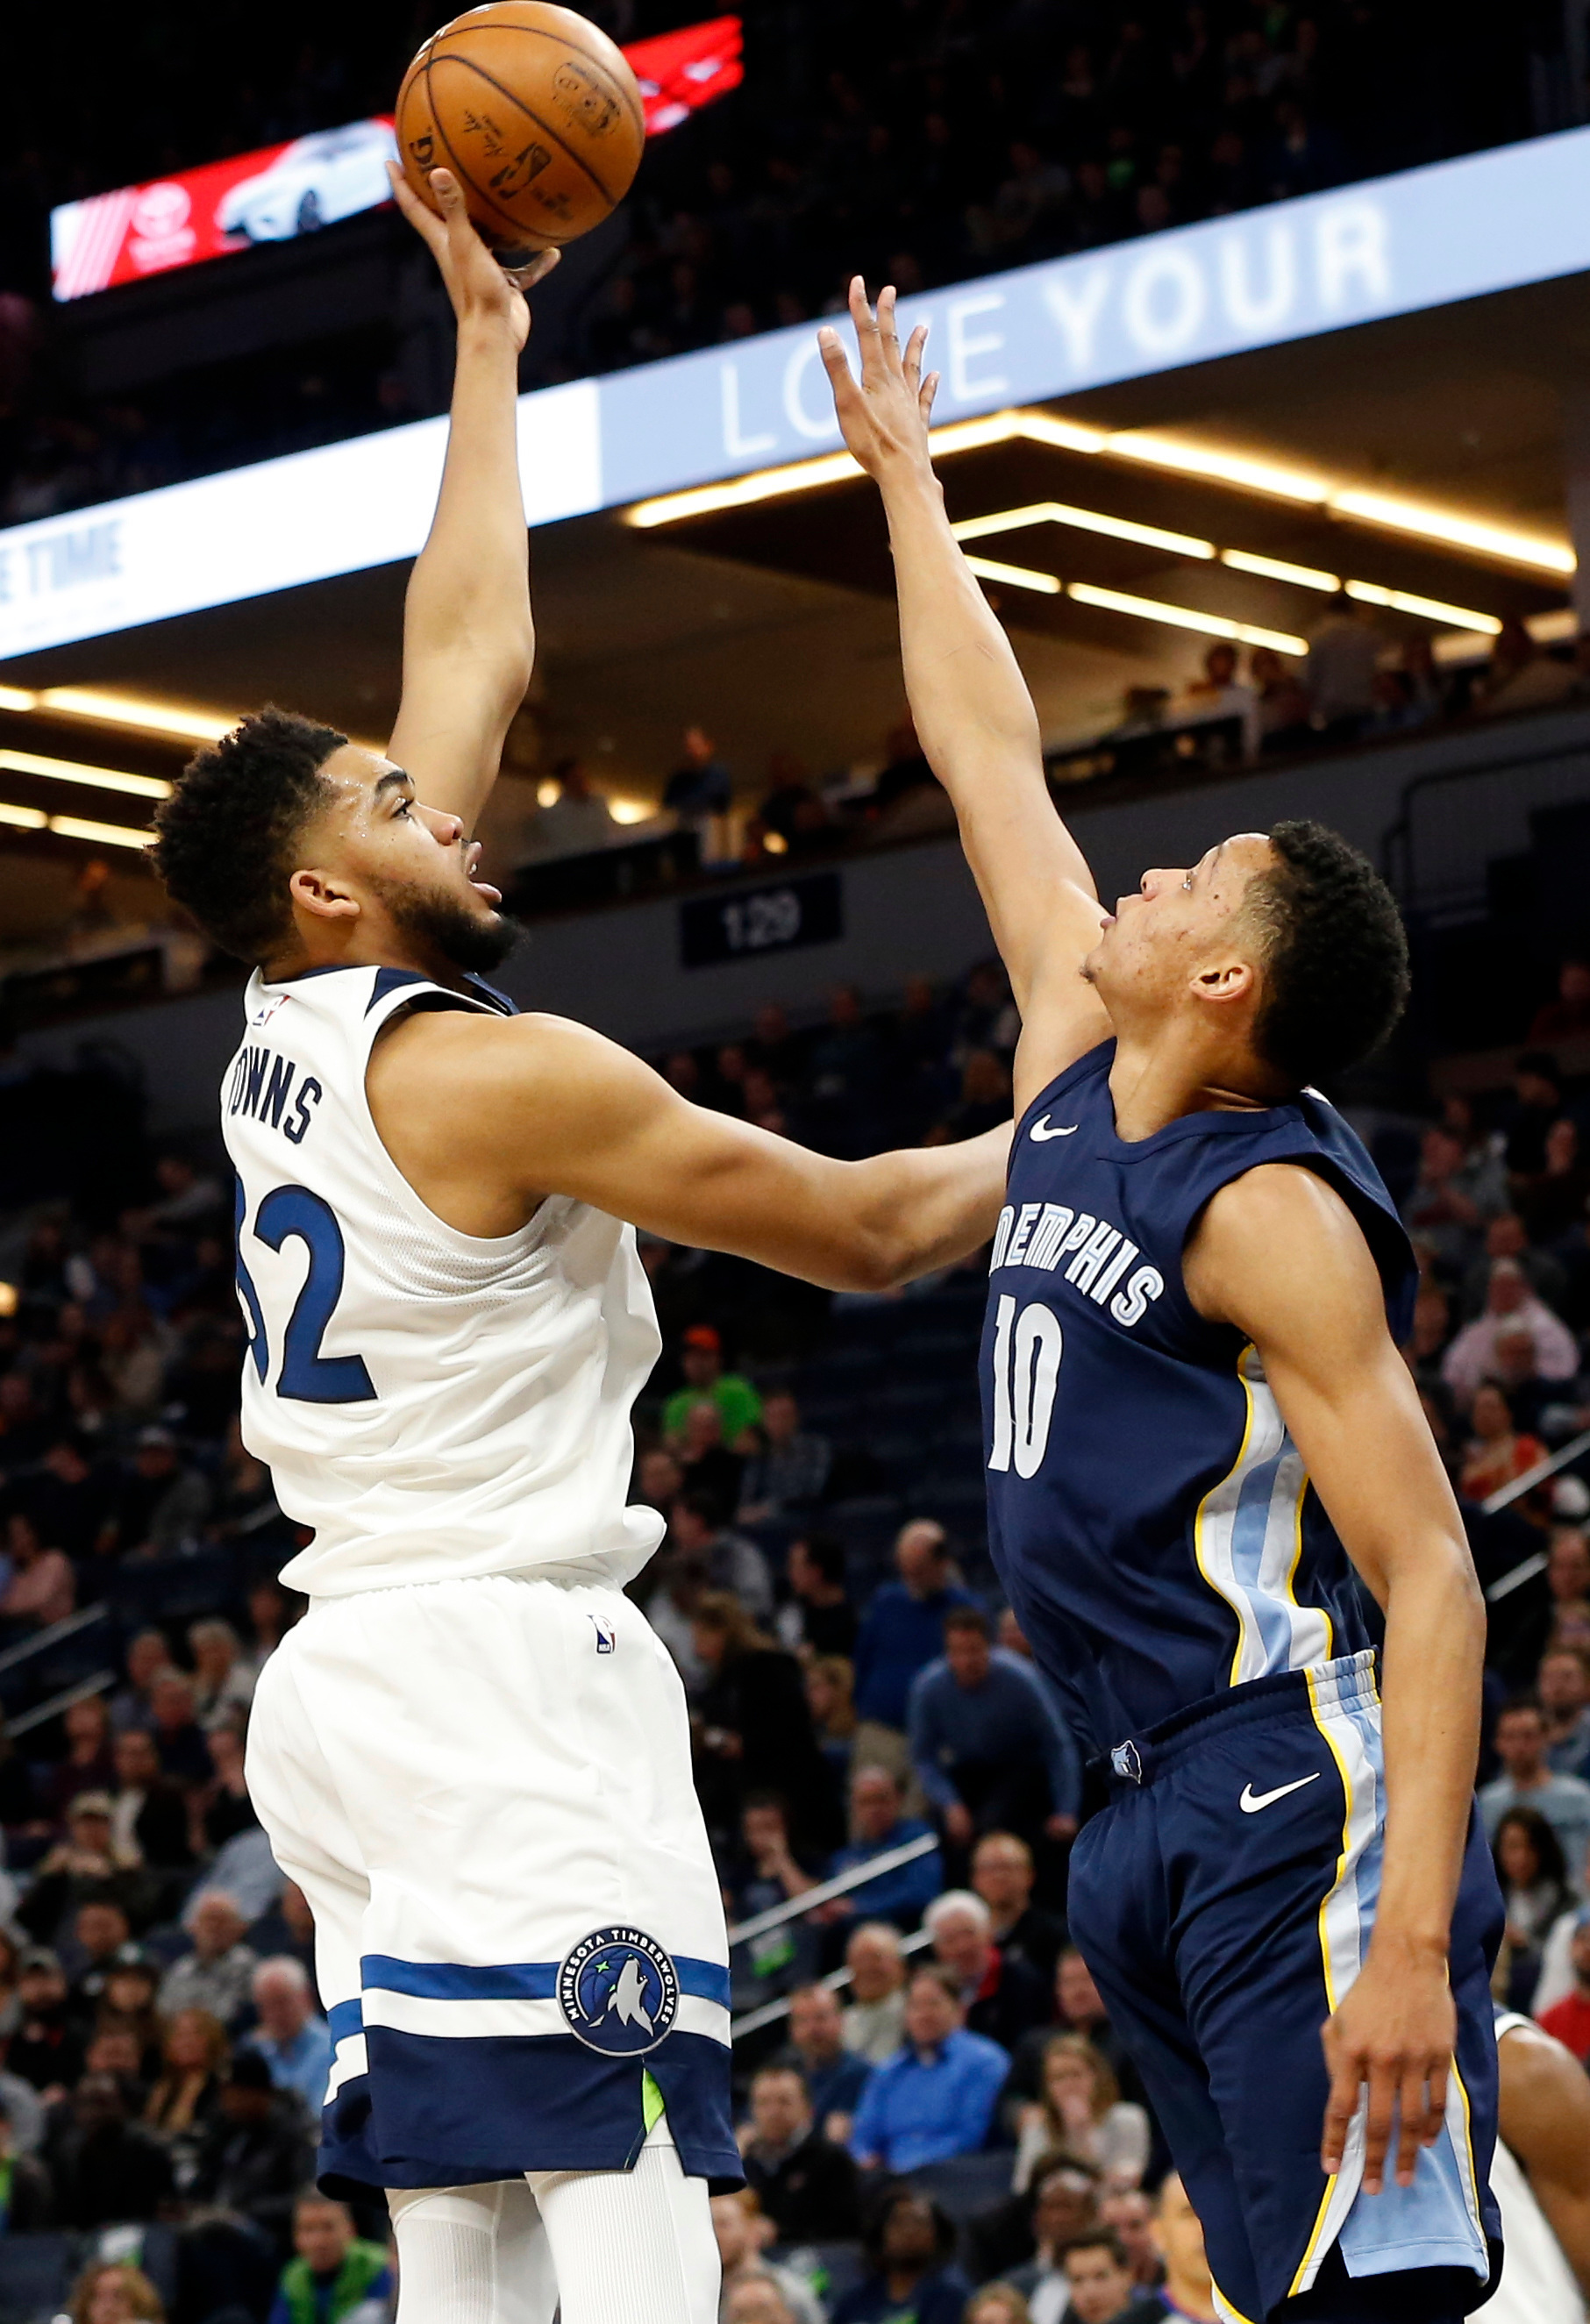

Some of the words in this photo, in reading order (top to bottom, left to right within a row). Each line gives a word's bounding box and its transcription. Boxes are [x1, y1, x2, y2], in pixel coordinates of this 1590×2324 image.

[721, 292, 1010, 459] LOE
[1041, 201, 1391, 374] YOUR
[226, 1045, 323, 1145] OWNS
[988, 1202, 1166, 1328] MEMPHIS
[988, 1293, 1063, 1480] 10
[562, 1934, 606, 2021] MINNESOTA
[610, 1929, 675, 2025] TIMBERWOLVES
